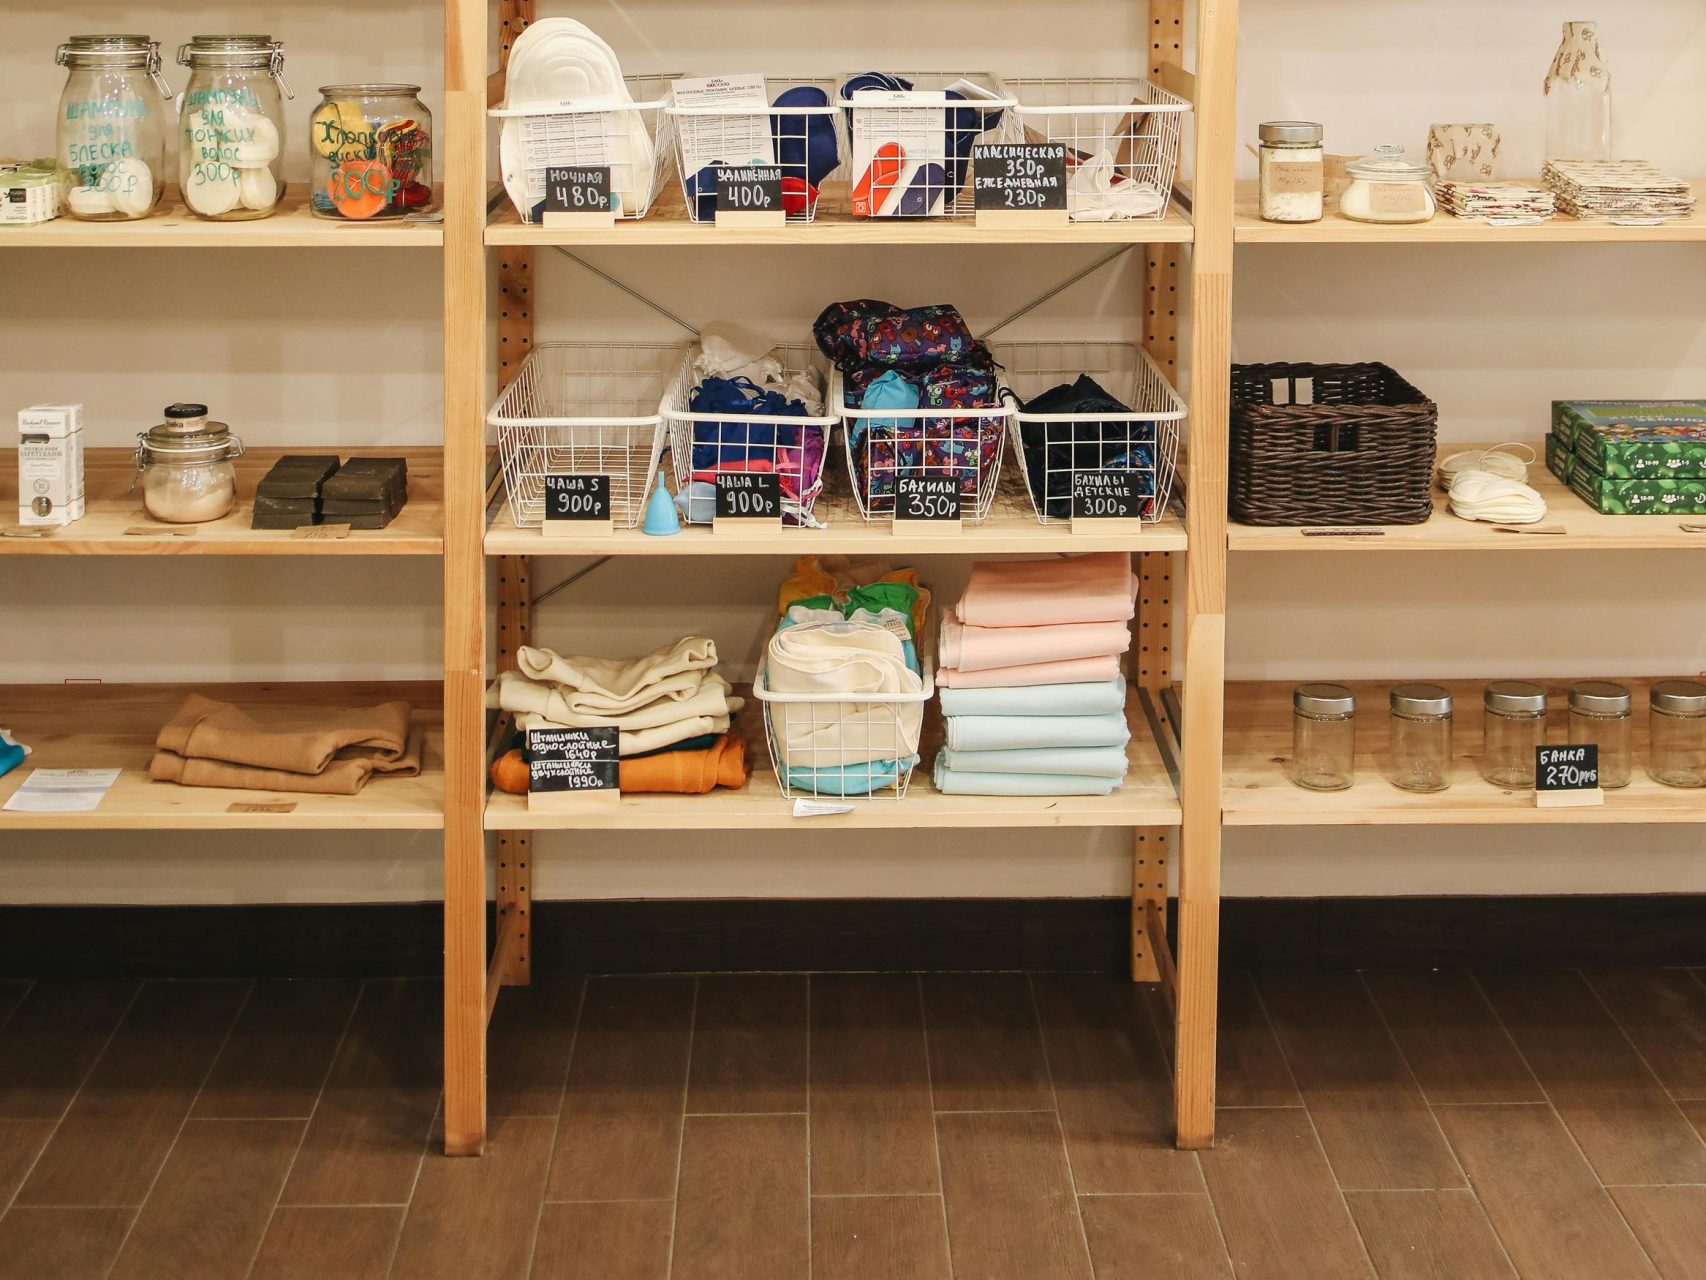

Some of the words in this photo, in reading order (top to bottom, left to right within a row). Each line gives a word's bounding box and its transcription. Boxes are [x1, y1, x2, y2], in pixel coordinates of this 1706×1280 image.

[68, 140, 134, 162] БЛЕСКА
[974, 145, 1064, 160] КЛАССИЧЕСКАЯ
[550, 169, 603, 184] НОЧНАЯ
[975, 176, 1058, 190] ЕЖЕДНЕВНАЯ
[546, 477, 585, 491] ЧАША
[590, 478, 600, 492] S
[716, 475, 753, 489] ЧАША
[758, 476, 770, 488] L
[900, 479, 956, 494] БАХИЛЫ
[1074, 473, 1125, 487] БАХИЛЫ
[1074, 486, 1131, 499] ДЕТСКИЕ
[1540, 748, 1586, 765] БАНКА
